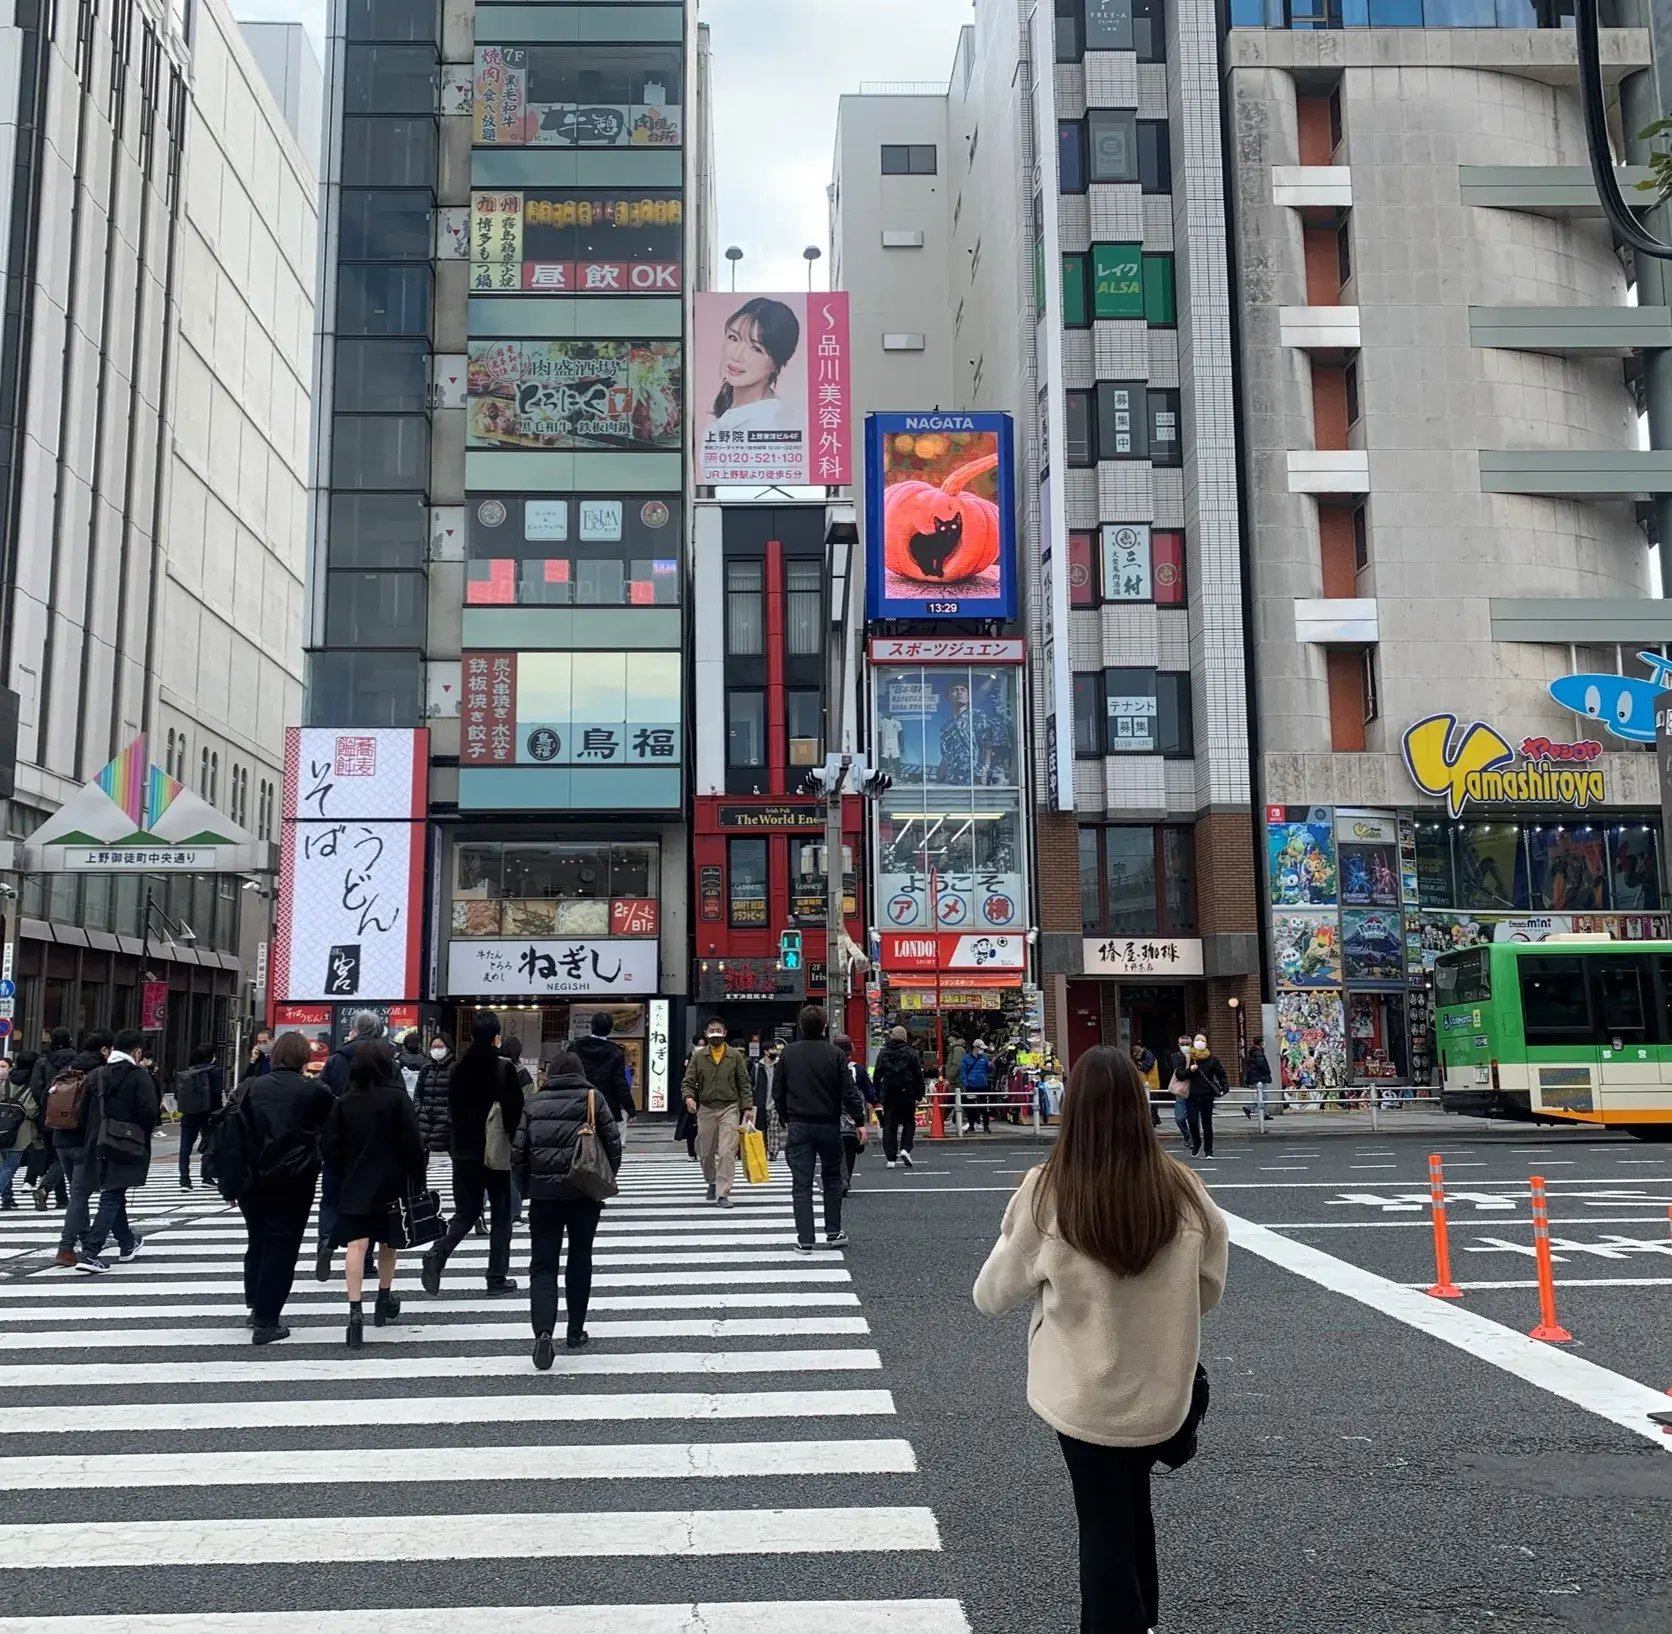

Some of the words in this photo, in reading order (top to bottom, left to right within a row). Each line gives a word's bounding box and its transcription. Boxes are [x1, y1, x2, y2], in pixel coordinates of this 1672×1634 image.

[503, 49, 525, 62] 7F
[501, 74, 518, 129] 黒毛和牛
[475, 216, 493, 289] 博多もつ鍋
[1097, 263, 1138, 277] レイク
[1096, 281, 1140, 294] ALSA
[532, 360, 620, 377] 肉盛酒場
[818, 334, 843, 480] 品川美容外科
[520, 421, 570, 434] 黒毛和牛
[578, 421, 631, 434] 鉄板肉鍋
[906, 416, 974, 430] NAGATA
[1115, 393, 1130, 450] 募集中
[705, 430, 745, 443] 上野院
[719, 453, 803, 463] 0120-521-130
[705, 470, 803, 480] JR上野駅より徒歩5分
[929, 603, 957, 613] 13:29
[889, 643, 1009, 657] スポーツジュエン
[467, 658, 489, 759] 鉄板焼き餃子
[491, 658, 512, 760] 炭火串焼き・水炊き
[1109, 701, 1155, 712] テナント
[1118, 720, 1148, 733] 募集
[577, 728, 676, 760] 鳥福
[1402, 713, 1606, 819] Yamashiroya
[304, 759, 347, 861] そば
[735, 814, 758, 825] The
[758, 813, 795, 825] World
[85, 852, 196, 864] 上野御徒町中央通り
[342, 827, 400, 937] うどん
[900, 875, 1005, 894] ようこそ
[614, 902, 629, 918] 2F
[893, 897, 1010, 921] アメ横
[631, 919, 654, 932] B1F
[1527, 918, 1552, 928] mini
[476, 951, 502, 960] 牛たん
[1098, 940, 1180, 963] 椿屋珈琲
[489, 962, 512, 971] とろろ
[518, 944, 622, 984] ねぎし
[546, 983, 590, 991] NEGISHI
[650, 1030, 668, 1076] ねぎし
